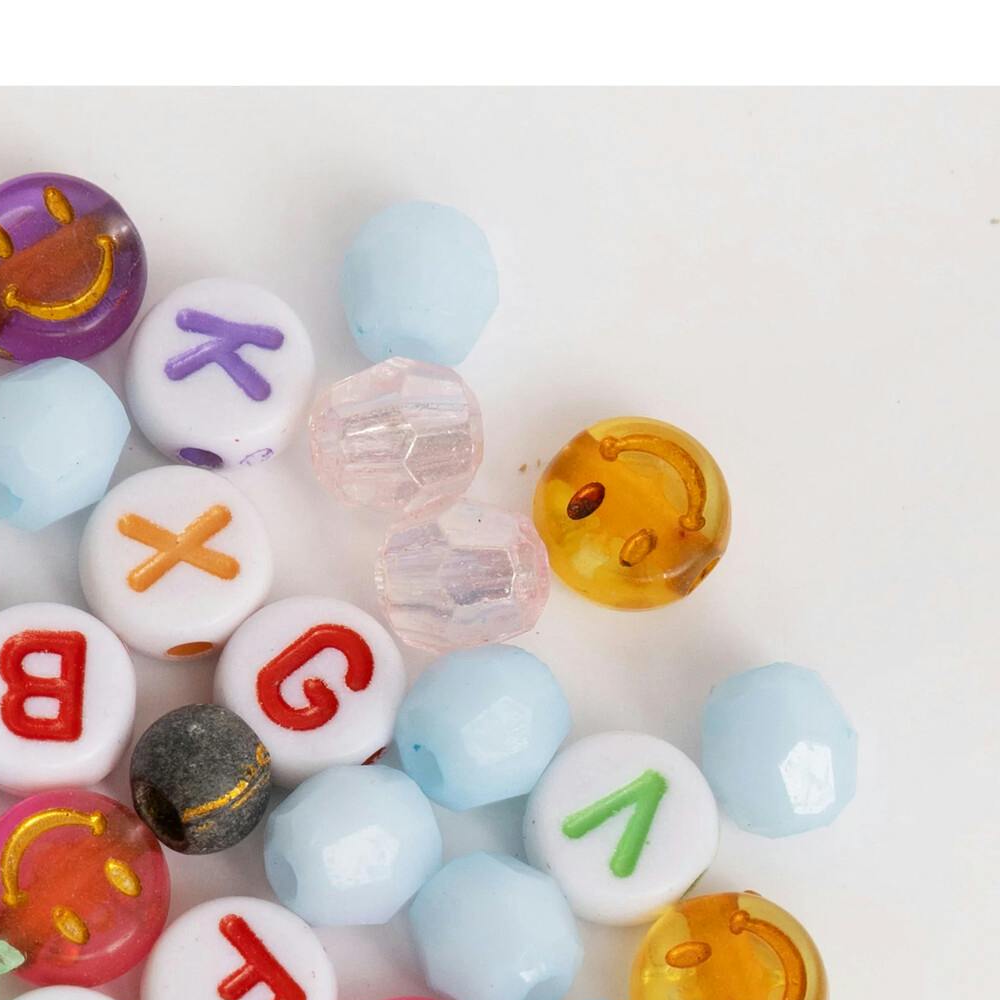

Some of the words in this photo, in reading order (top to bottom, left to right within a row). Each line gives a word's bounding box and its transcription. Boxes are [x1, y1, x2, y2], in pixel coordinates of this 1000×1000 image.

[166, 312, 283, 400] K
[116, 504, 240, 591] X
[255, 623, 375, 732] G
[563, 771, 667, 877] V
